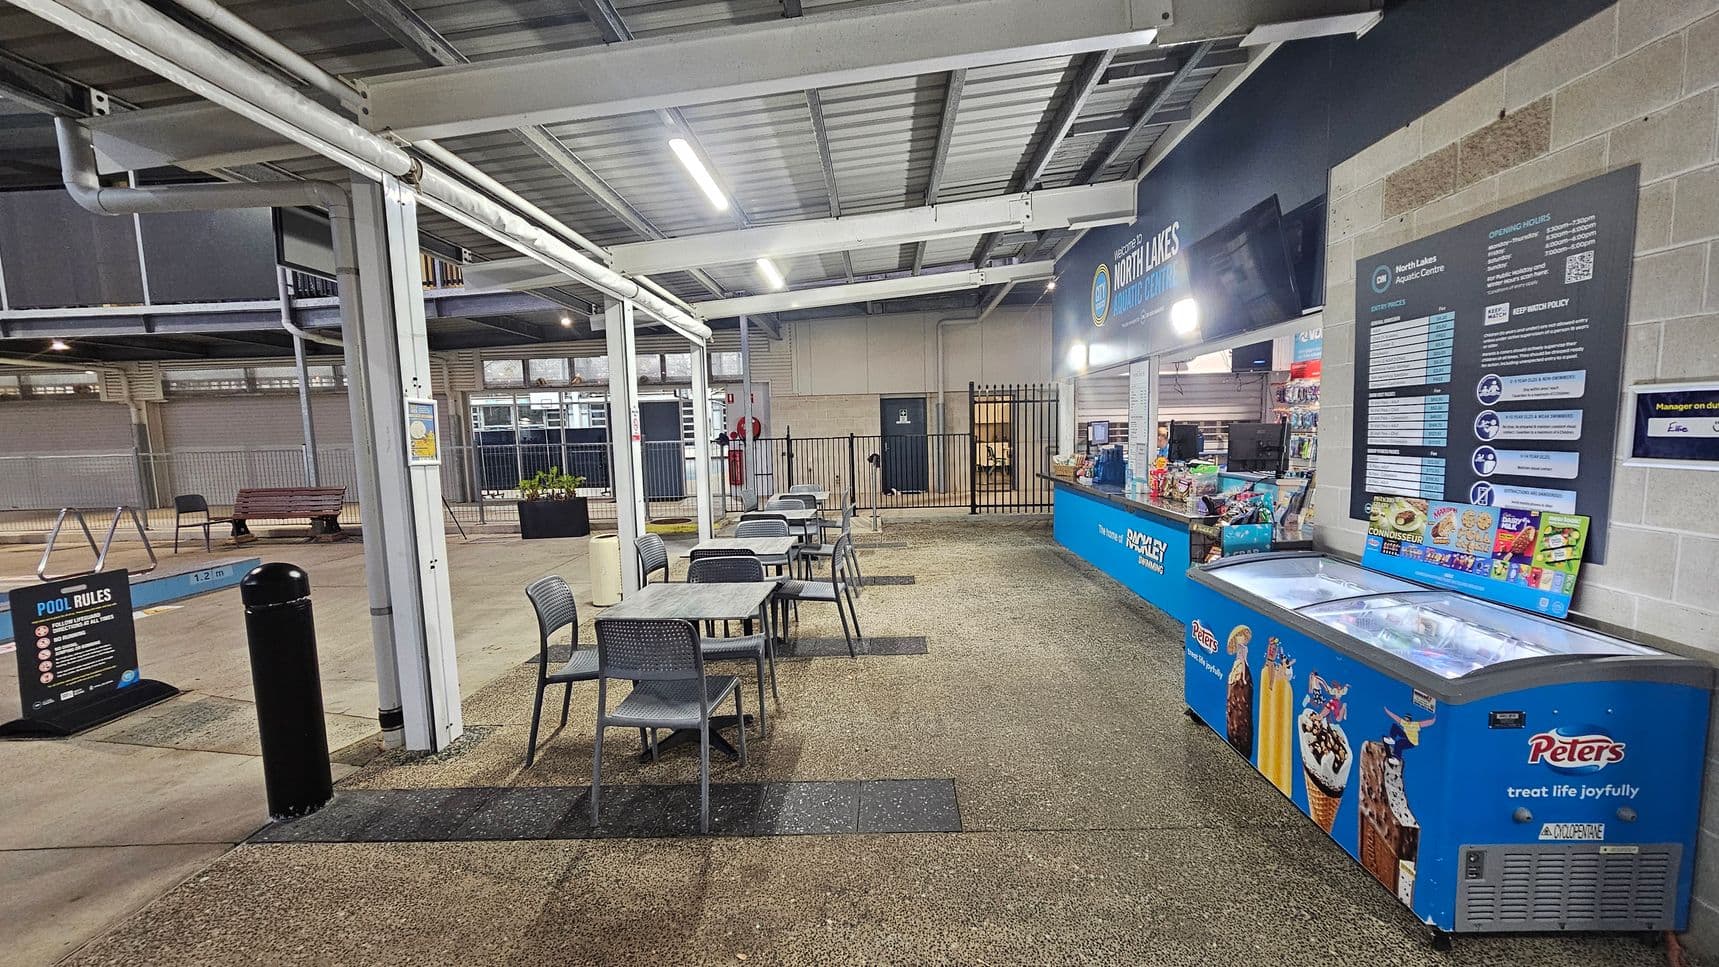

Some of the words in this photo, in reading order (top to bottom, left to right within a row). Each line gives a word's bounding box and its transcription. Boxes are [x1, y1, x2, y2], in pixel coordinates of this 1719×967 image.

[1488, 222, 1521, 239] OPENING
[1522, 212, 1551, 228] HOURS
[1136, 233, 1143, 245] to
[1114, 245, 1143, 291] NORTH
[1146, 221, 1179, 272] LAKES
[1396, 260, 1415, 273] North
[1416, 255, 1437, 267] Lakes
[1395, 271, 1420, 284] Aquatic
[1421, 264, 1445, 277] Centre
[1533, 262, 1545, 271] and
[1113, 281, 1142, 316] AQUATIC
[1513, 307, 1527, 316] KEEP
[1527, 302, 1547, 313] WATCH
[1547, 298, 1570, 309] POLICY
[1656, 402, 1692, 412] Manager
[1501, 516, 1520, 524] DAIRY
[1501, 522, 1517, 531] MILK
[1098, 524, 1106, 535] The
[1118, 534, 1124, 544] of
[1368, 527, 1424, 545] CONNOISSEUR
[1126, 528, 1168, 563] RACKLEY
[1138, 555, 1165, 576] SWIMMING
[194, 571, 211, 582] 1.2
[37, 597, 72, 616] POOL
[74, 588, 112, 609] RULES
[52, 618, 73, 628] FOLLOW
[1192, 621, 1218, 653] Peters
[1205, 661, 1223, 680] joyfully
[1530, 734, 1625, 764] Peters
[1507, 785, 1548, 798] treat
[1552, 784, 1577, 797] life
[1580, 784, 1640, 799] joyfully
[1553, 824, 1603, 839] CYCLOPENTANE
